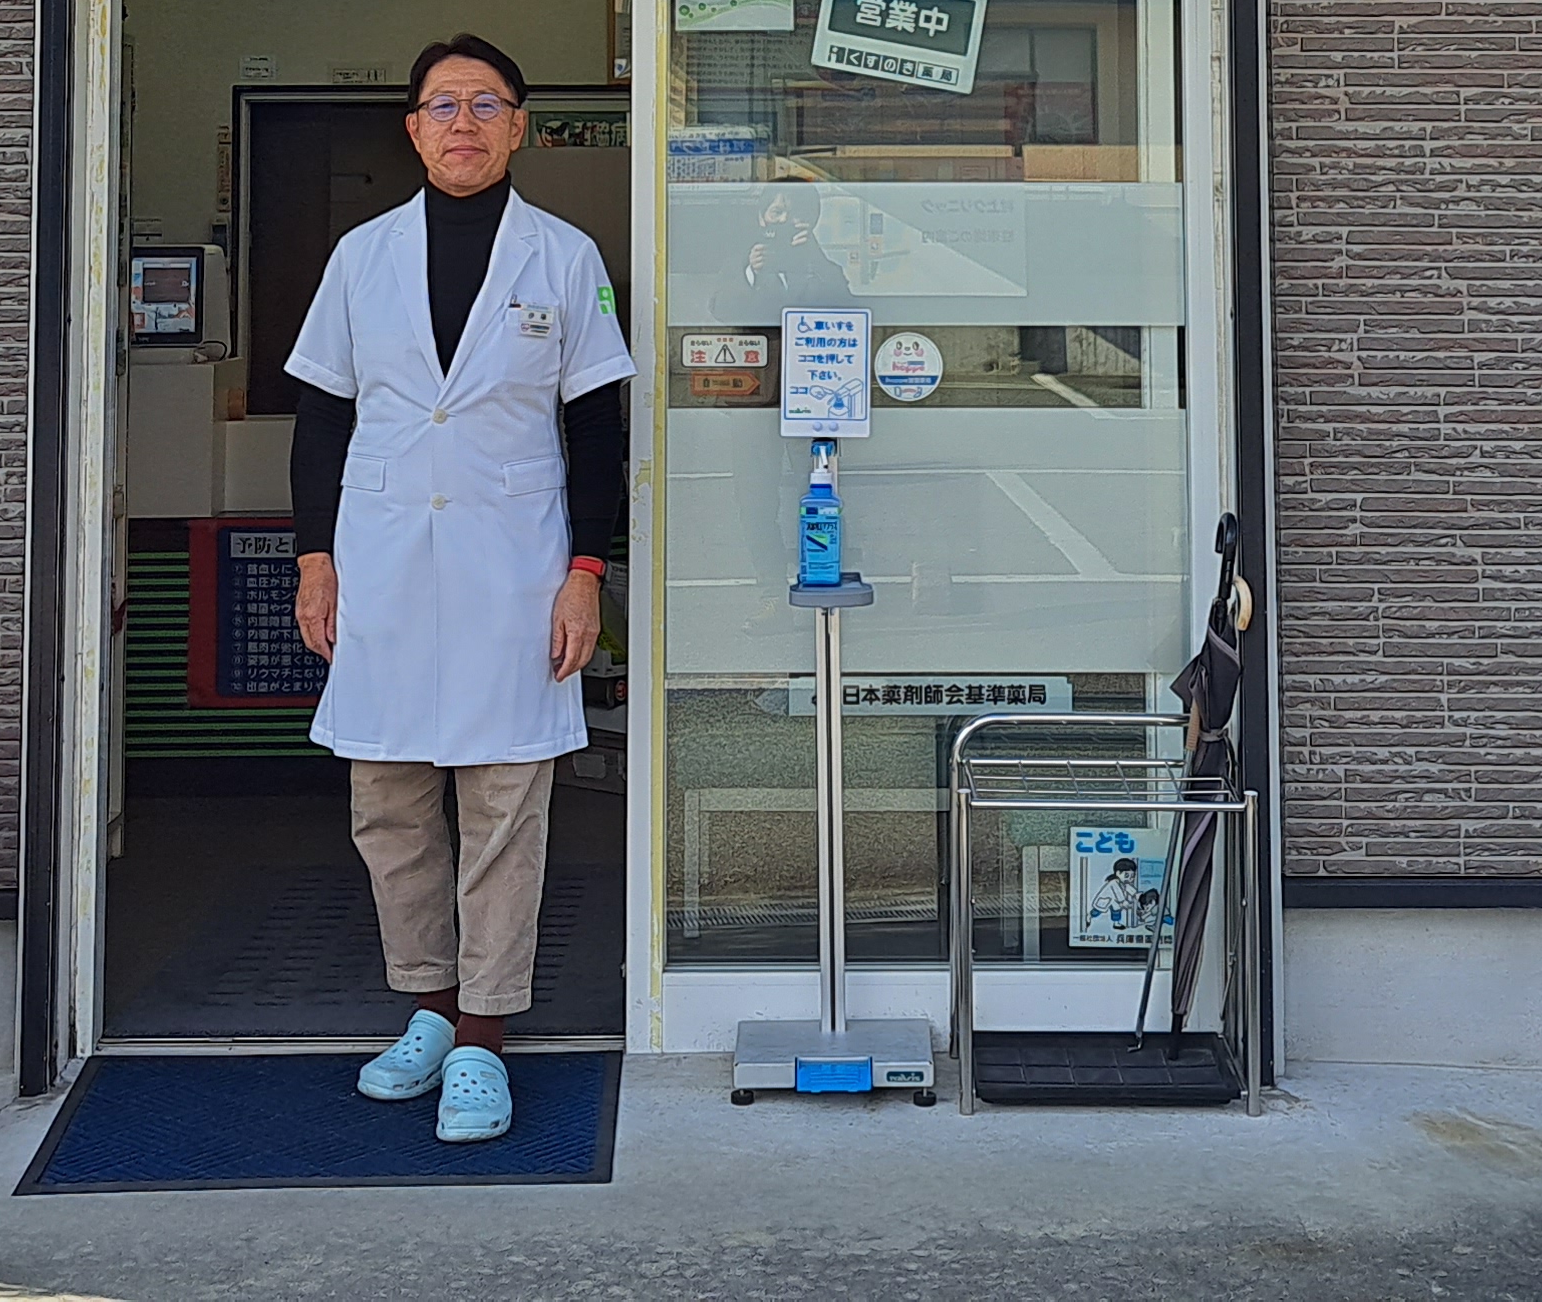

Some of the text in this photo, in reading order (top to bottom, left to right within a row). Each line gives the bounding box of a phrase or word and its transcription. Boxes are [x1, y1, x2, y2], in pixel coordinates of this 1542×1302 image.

[814, 320, 855, 332] 車いすを
[794, 336, 858, 348] ご利用の方は
[797, 353, 855, 365] ココを押して
[806, 369, 842, 381] 下さい。
[789, 386, 809, 395] ココ
[235, 536, 298, 555] 予防と
[246, 590, 299, 602] ホルモン
[812, 683, 1047, 706] 日本薬剤師会基準薬局
[1075, 831, 1136, 854] こども
